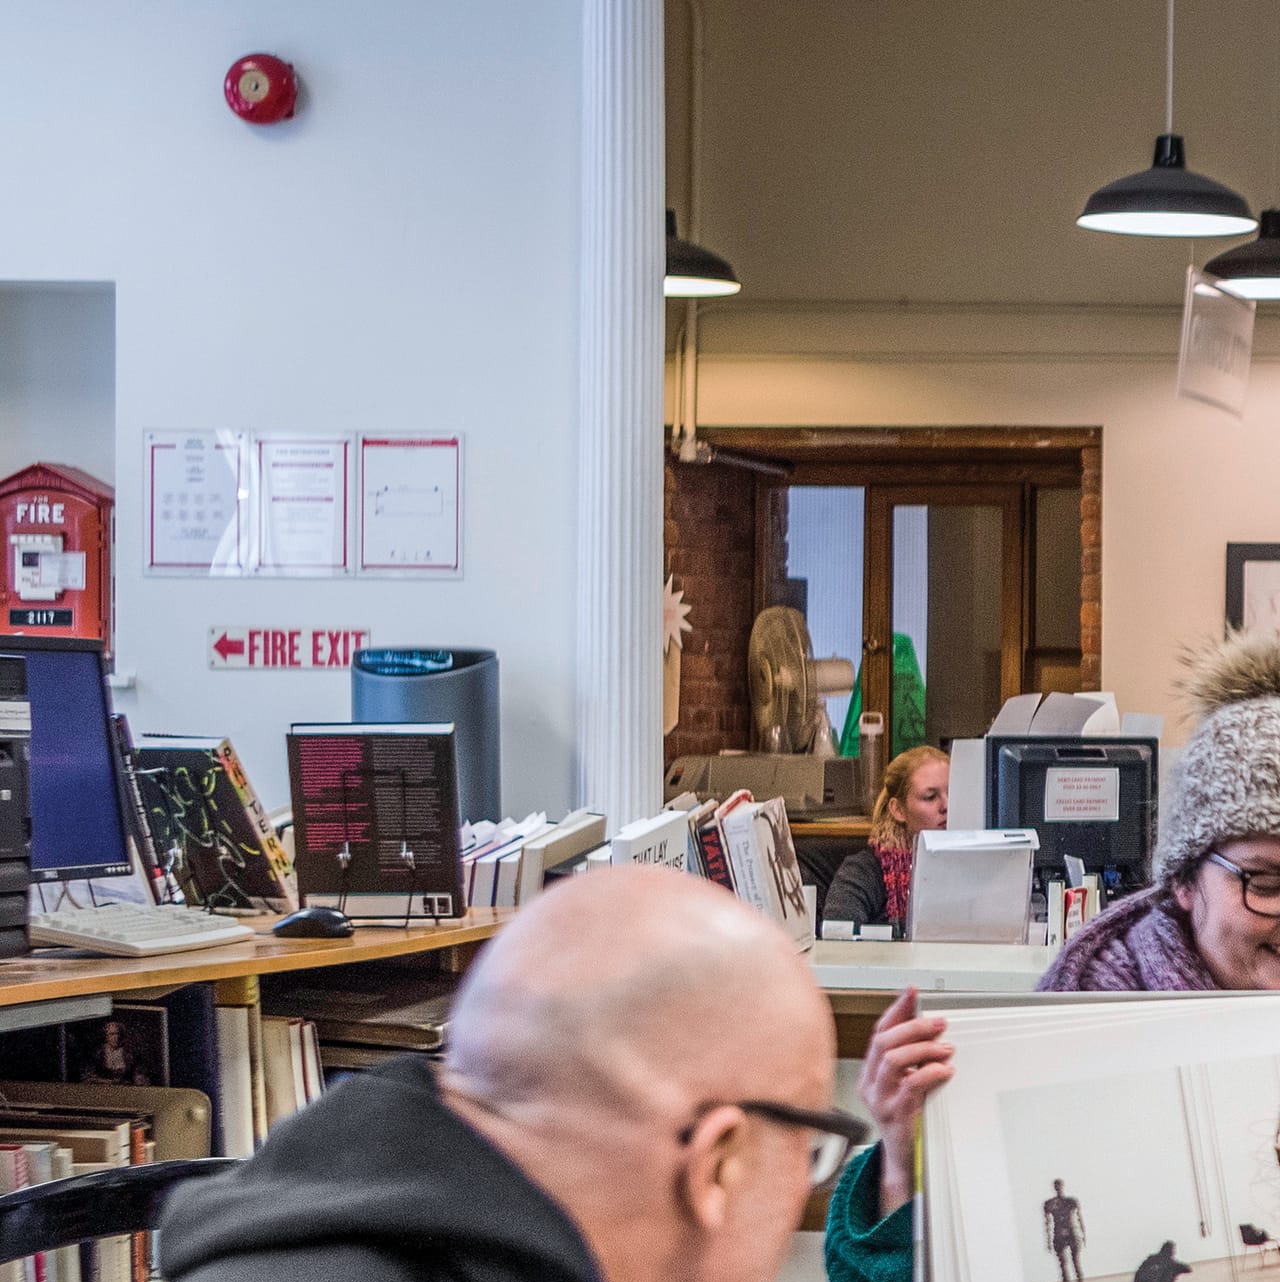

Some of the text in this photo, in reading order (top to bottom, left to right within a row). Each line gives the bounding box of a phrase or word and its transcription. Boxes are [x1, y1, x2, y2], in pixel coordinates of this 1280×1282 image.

[16, 503, 64, 524] FIRE
[27, 610, 55, 625] 2117
[248, 629, 366, 667] FIRE EXIT
[653, 839, 669, 862] LAY
